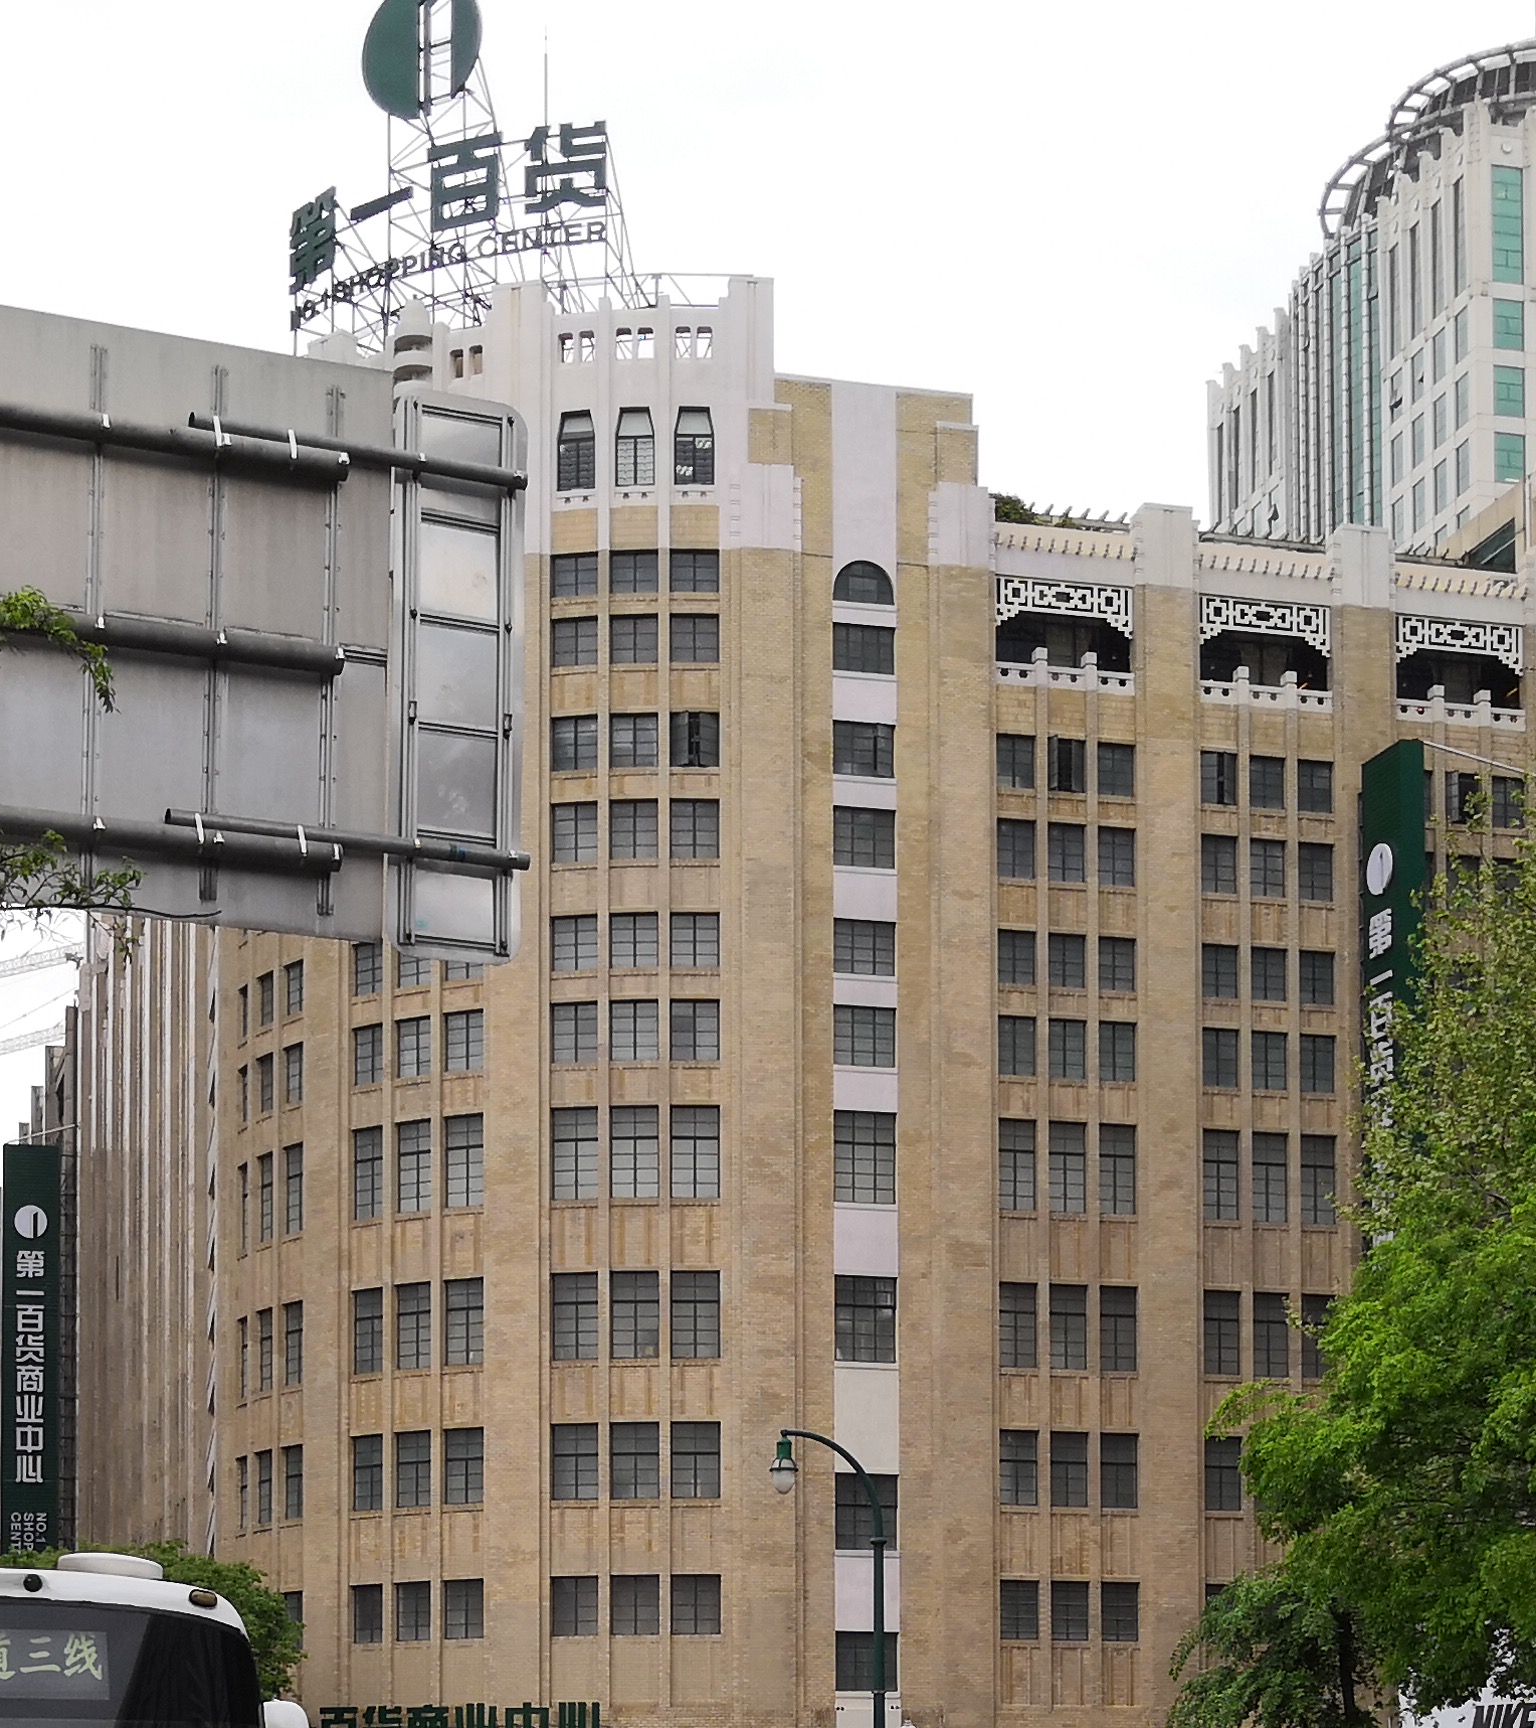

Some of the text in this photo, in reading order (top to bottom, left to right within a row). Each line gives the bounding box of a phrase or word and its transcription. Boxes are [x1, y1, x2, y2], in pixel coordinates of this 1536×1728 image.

[289, 120, 606, 295] 第一百货
[331, 242, 464, 302] SHOPPING
[477, 221, 607, 256] CENTER
[15, 1250, 45, 1484] 第一百货商业中心
[35, 1512, 47, 1543] NO.1
